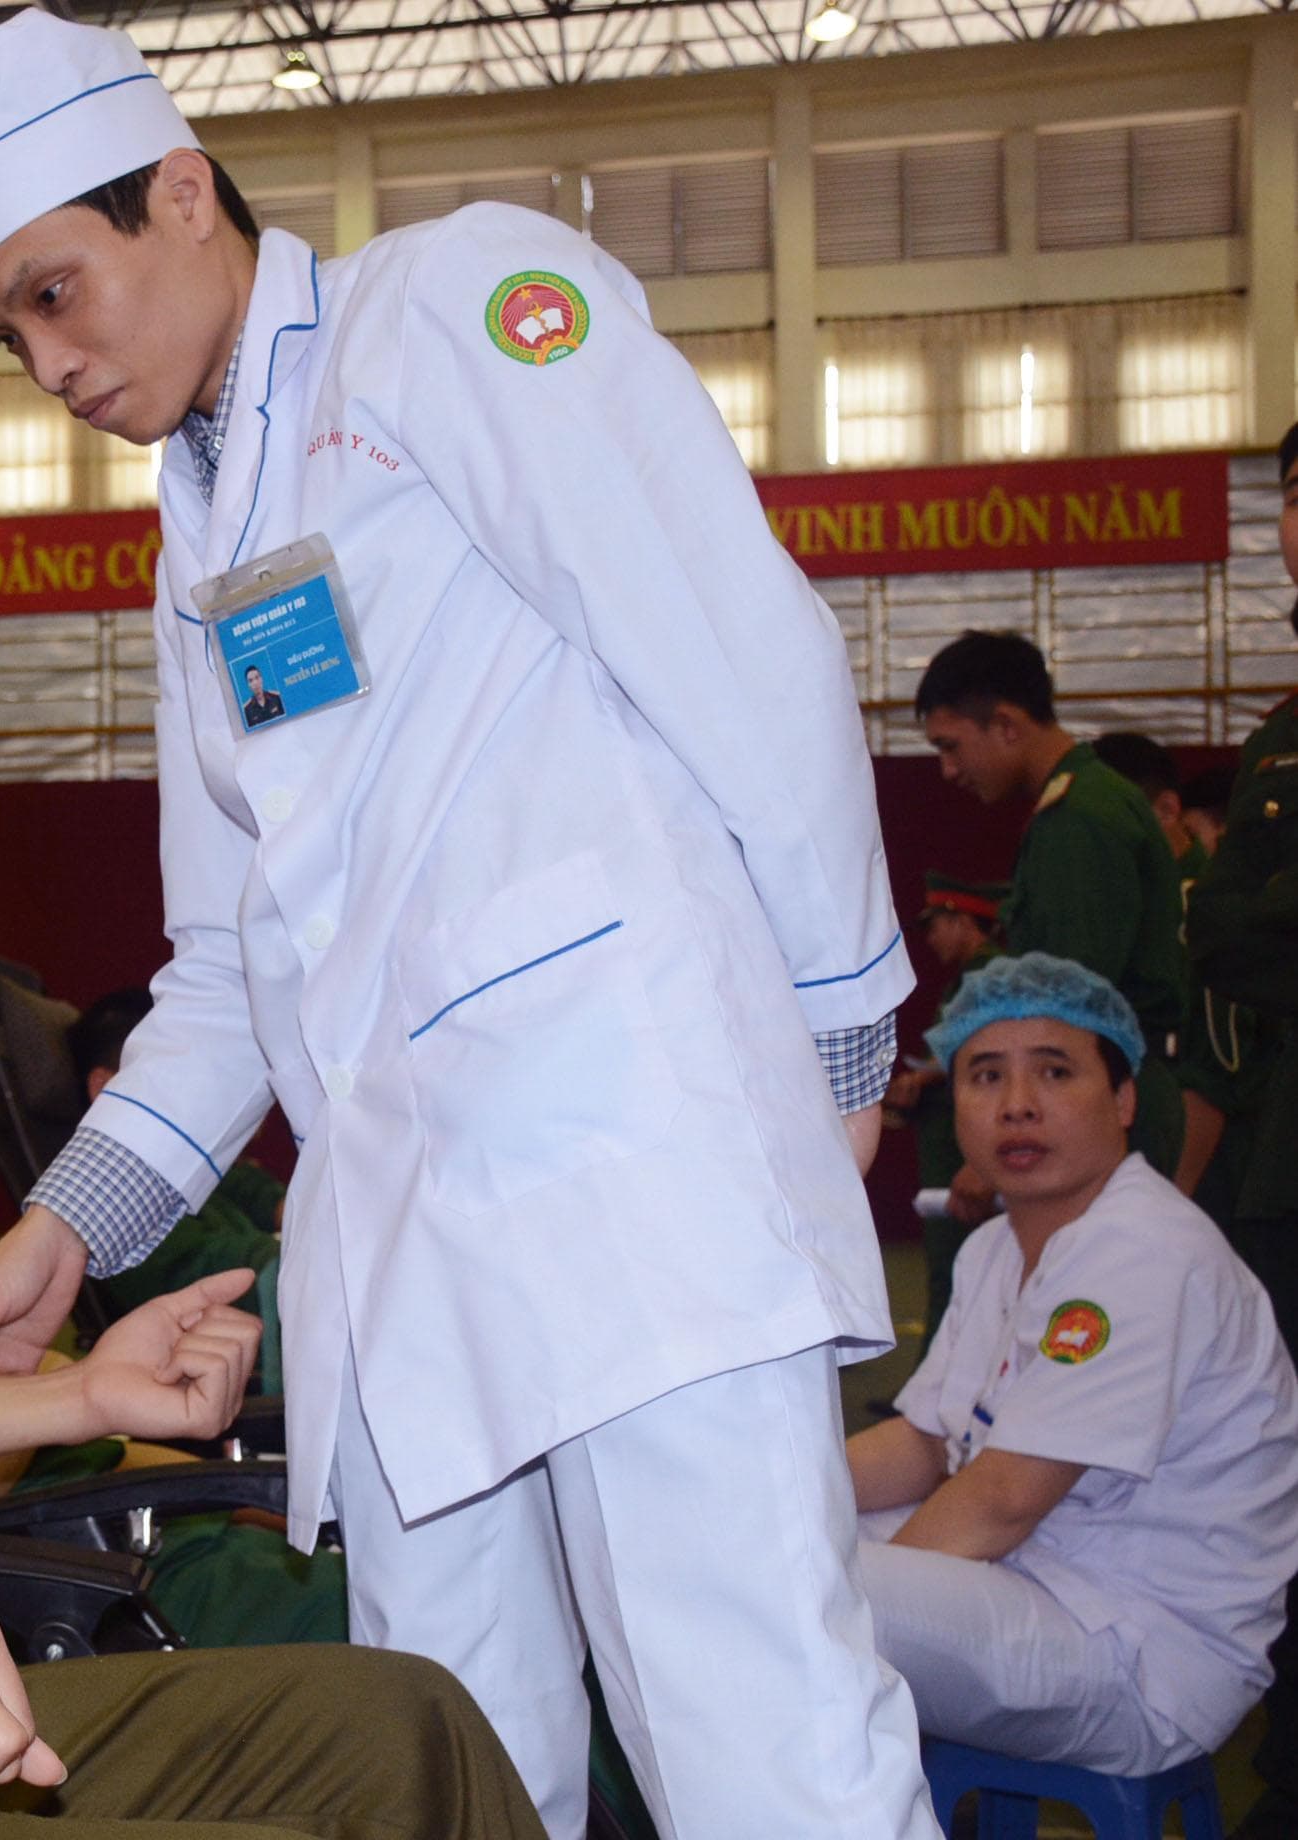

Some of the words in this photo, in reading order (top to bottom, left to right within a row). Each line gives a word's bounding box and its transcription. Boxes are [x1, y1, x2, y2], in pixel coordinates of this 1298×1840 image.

[350, 433, 364, 450] Y
[368, 445, 401, 472] 103
[764, 502, 886, 555] VINH
[897, 485, 1053, 551] MUÔN
[1063, 482, 1185, 545] NĂM
[105, 528, 163, 599] CỘ
